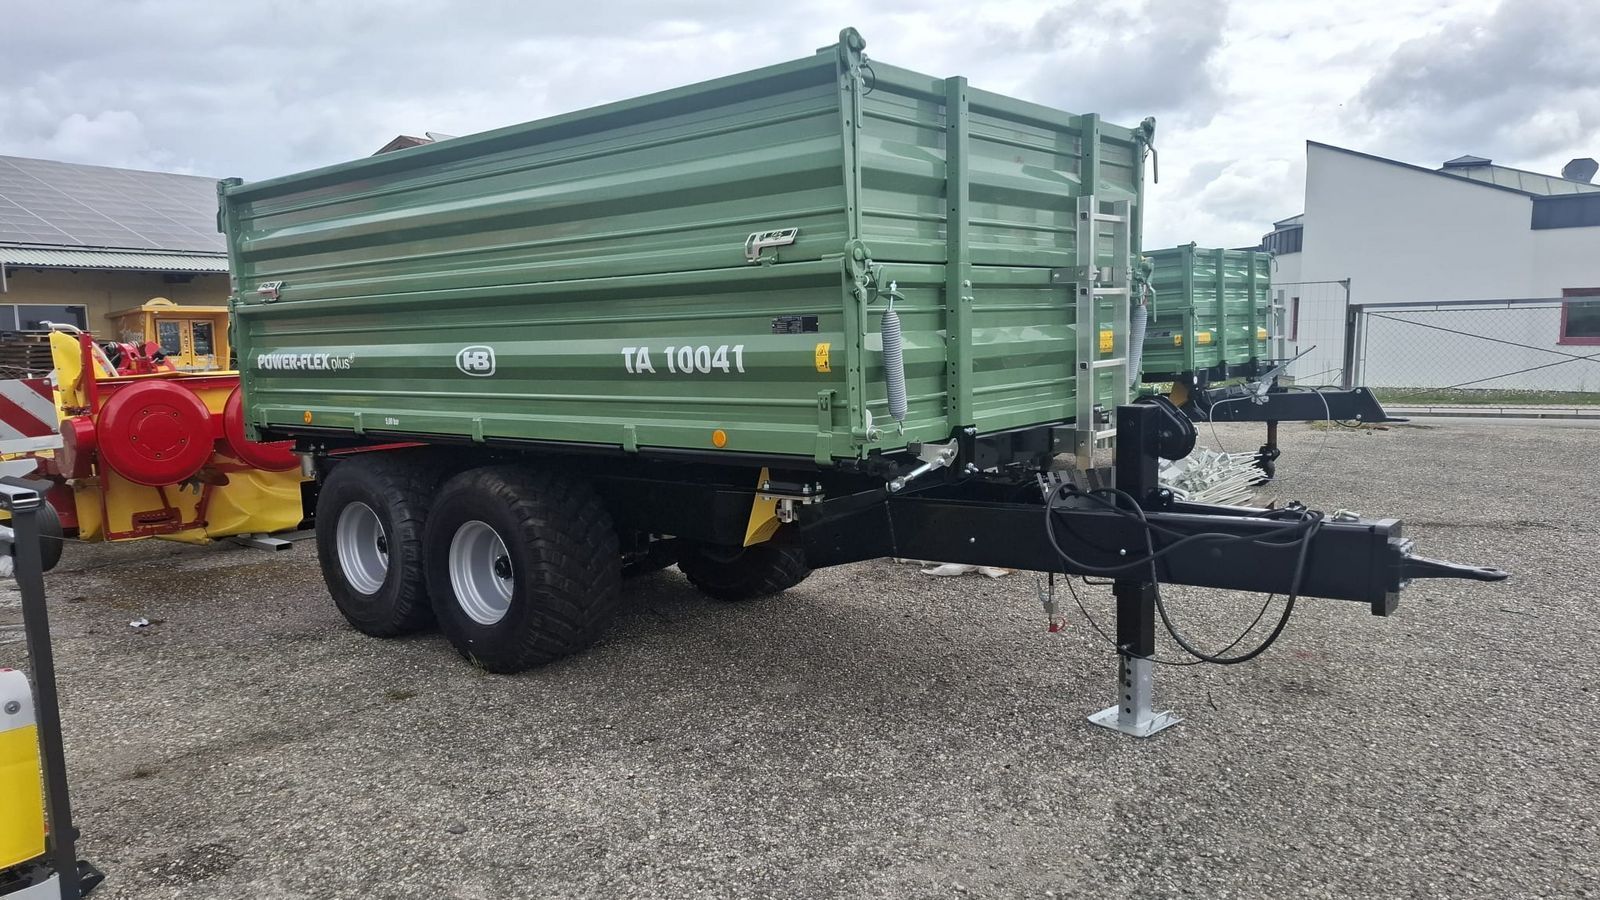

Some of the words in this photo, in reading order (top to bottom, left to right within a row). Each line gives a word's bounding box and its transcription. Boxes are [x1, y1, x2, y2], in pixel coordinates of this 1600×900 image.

[463, 351, 490, 371] HB
[621, 346, 656, 374] TA
[664, 344, 745, 374] 10041
